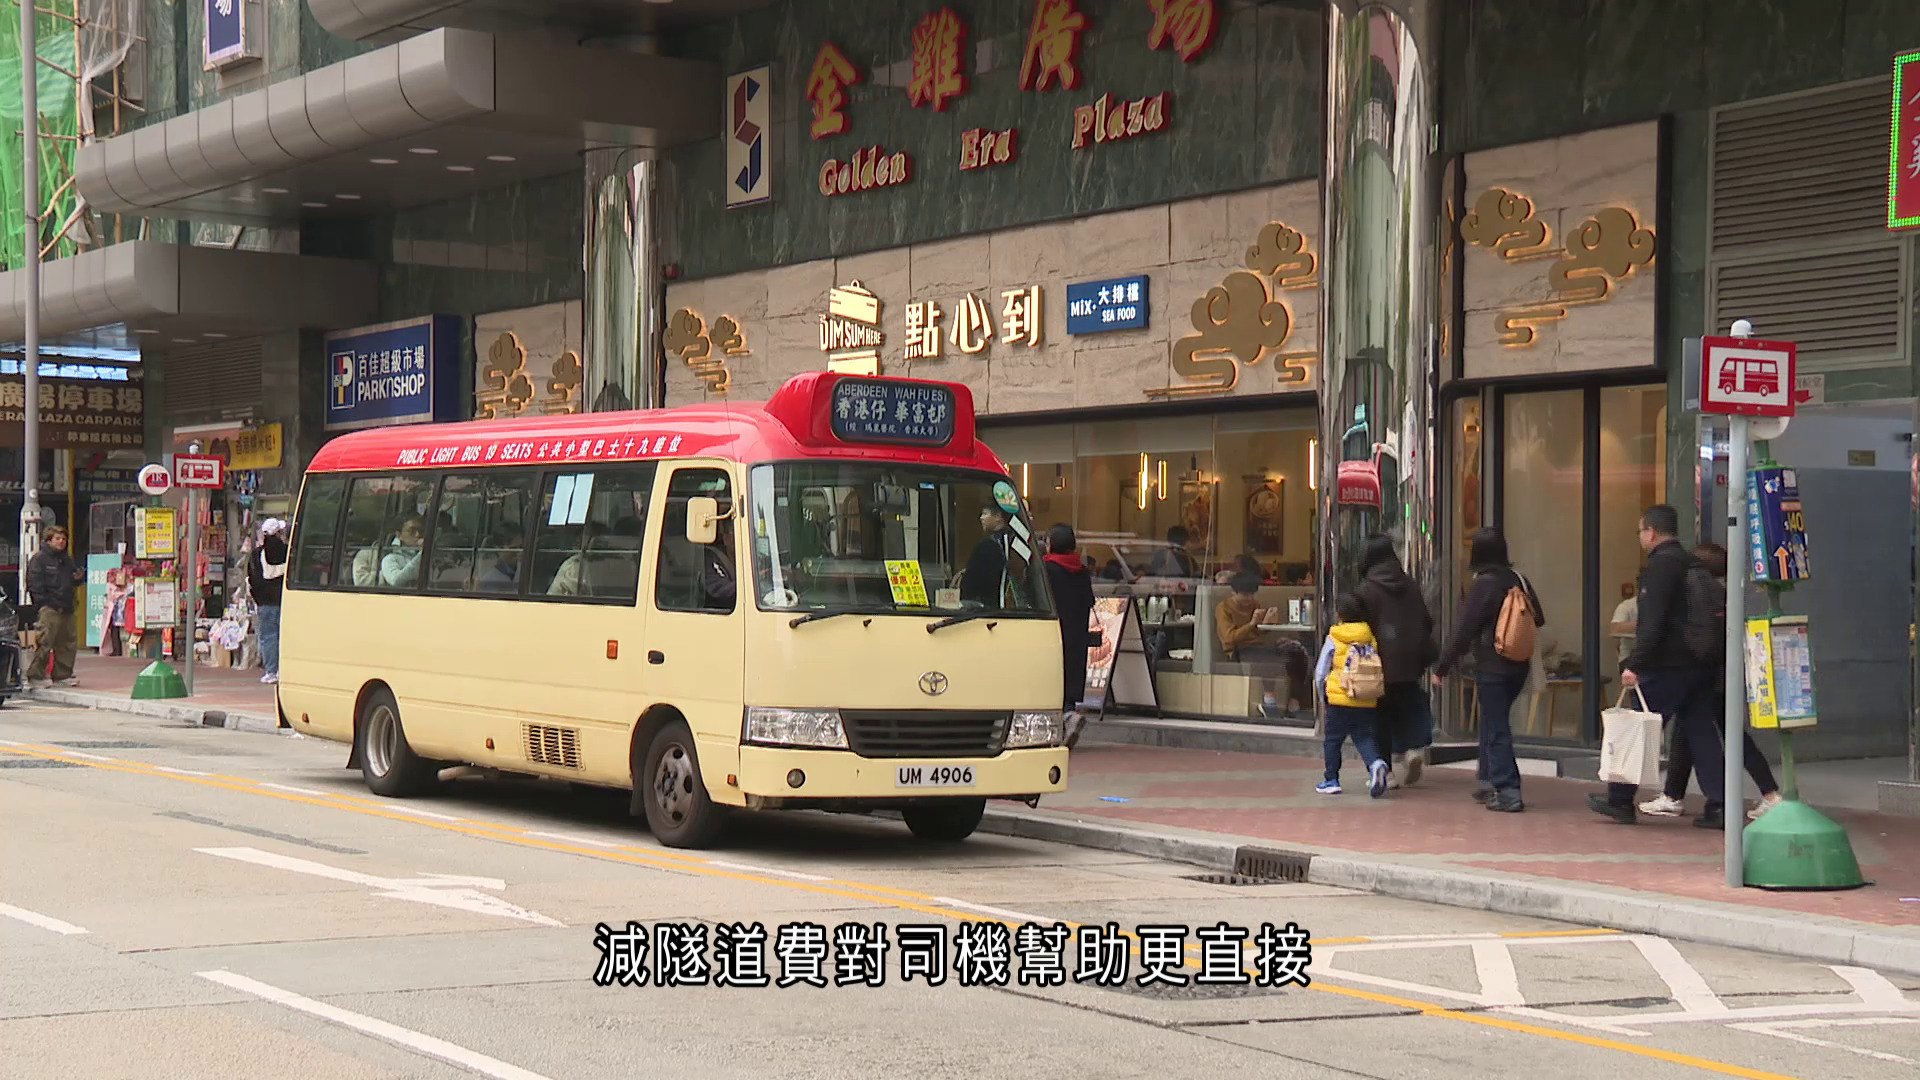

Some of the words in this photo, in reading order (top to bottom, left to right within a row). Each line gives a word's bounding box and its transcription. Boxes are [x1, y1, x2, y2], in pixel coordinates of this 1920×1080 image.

[819, 144, 909, 197] Golden
[960, 127, 1016, 170] Era
[1072, 90, 1170, 150] Plaza
[904, 284, 1044, 360] 點心到
[1102, 308, 1115, 323] SEA
[1117, 306, 1136, 321] FOOD
[358, 344, 425, 379] 百佳超級市場
[838, 384, 888, 398] ABERDEEN
[895, 387, 915, 401] WAH
[918, 388, 930, 401] FU
[39, 412, 73, 423] LAZA
[76, 414, 143, 426] CARPARK
[836, 397, 886, 420] 香港仔
[895, 400, 945, 424] 華富邨
[397, 449, 427, 464] PUBLIC
[430, 446, 459, 463] LIGHT
[461, 445, 482, 462] BUS
[485, 443, 497, 460] 19
[500, 442, 534, 460] SEATS
[899, 767, 922, 785] UM
[929, 767, 973, 784] 4906
